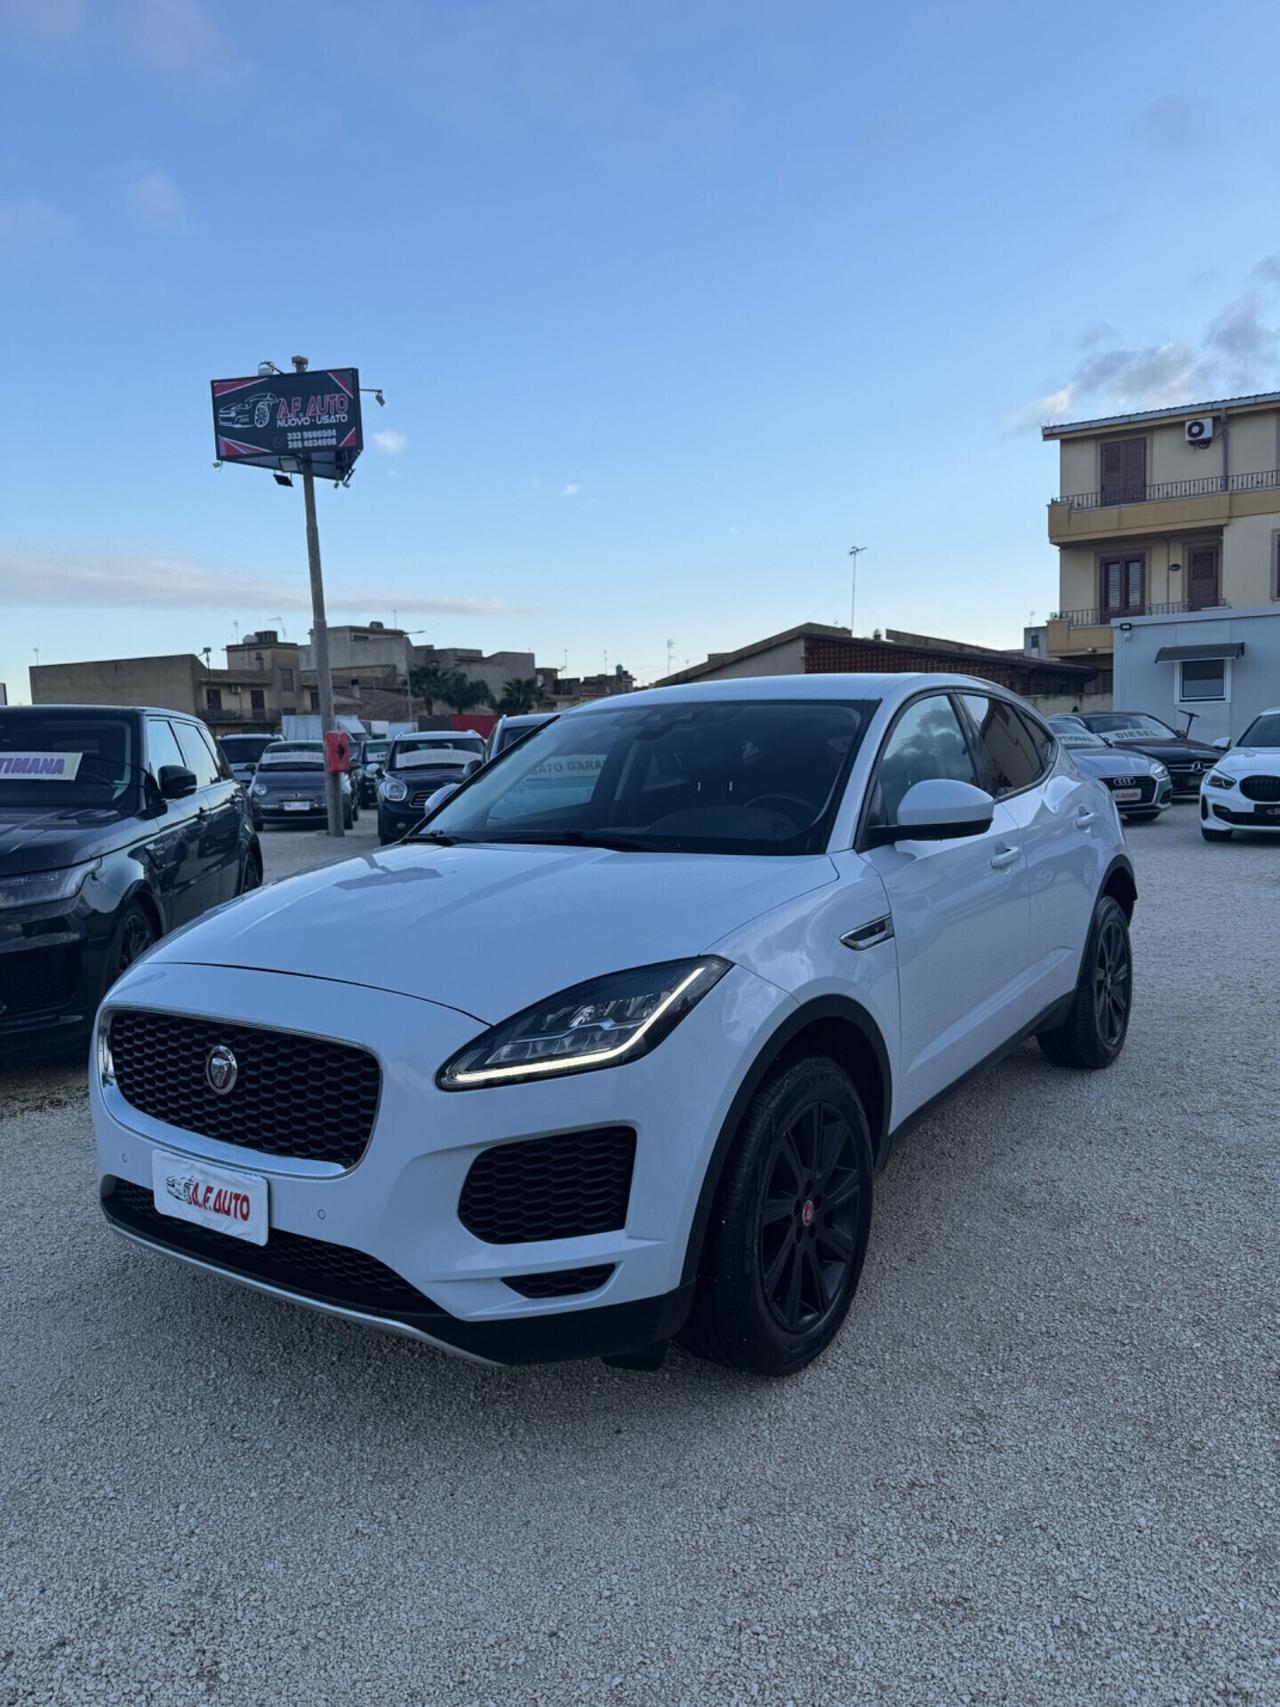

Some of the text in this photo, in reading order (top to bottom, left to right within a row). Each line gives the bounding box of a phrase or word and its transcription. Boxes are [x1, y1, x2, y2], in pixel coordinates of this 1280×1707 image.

[306, 393, 348, 416] AUTO
[277, 413, 348, 428] NUOVO USATO
[1115, 729, 1160, 739] DIESEL
